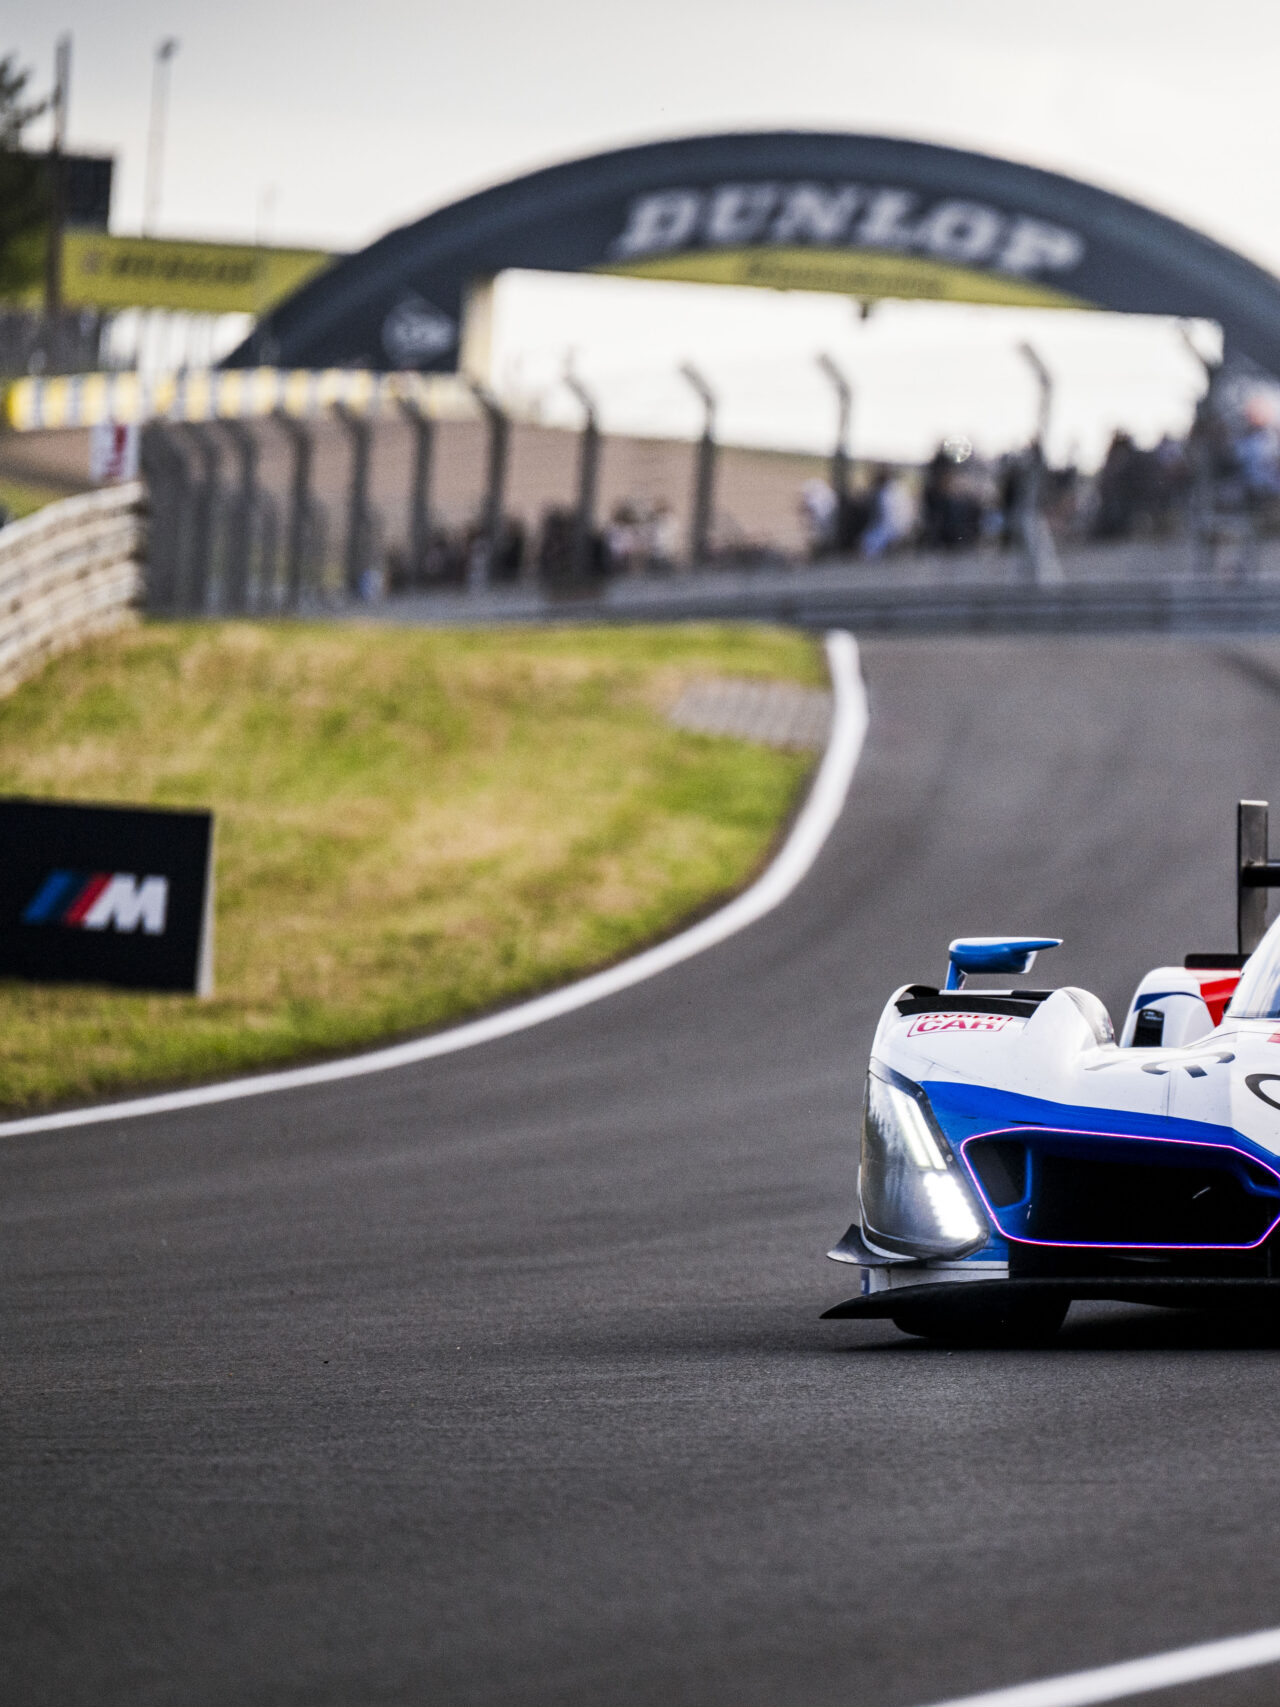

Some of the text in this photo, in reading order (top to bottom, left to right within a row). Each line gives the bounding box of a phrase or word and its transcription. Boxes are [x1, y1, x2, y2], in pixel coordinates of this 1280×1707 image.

[611, 182, 1084, 273] DUNLOP
[82, 872, 168, 935] M
[917, 1019, 995, 1032] CAR
